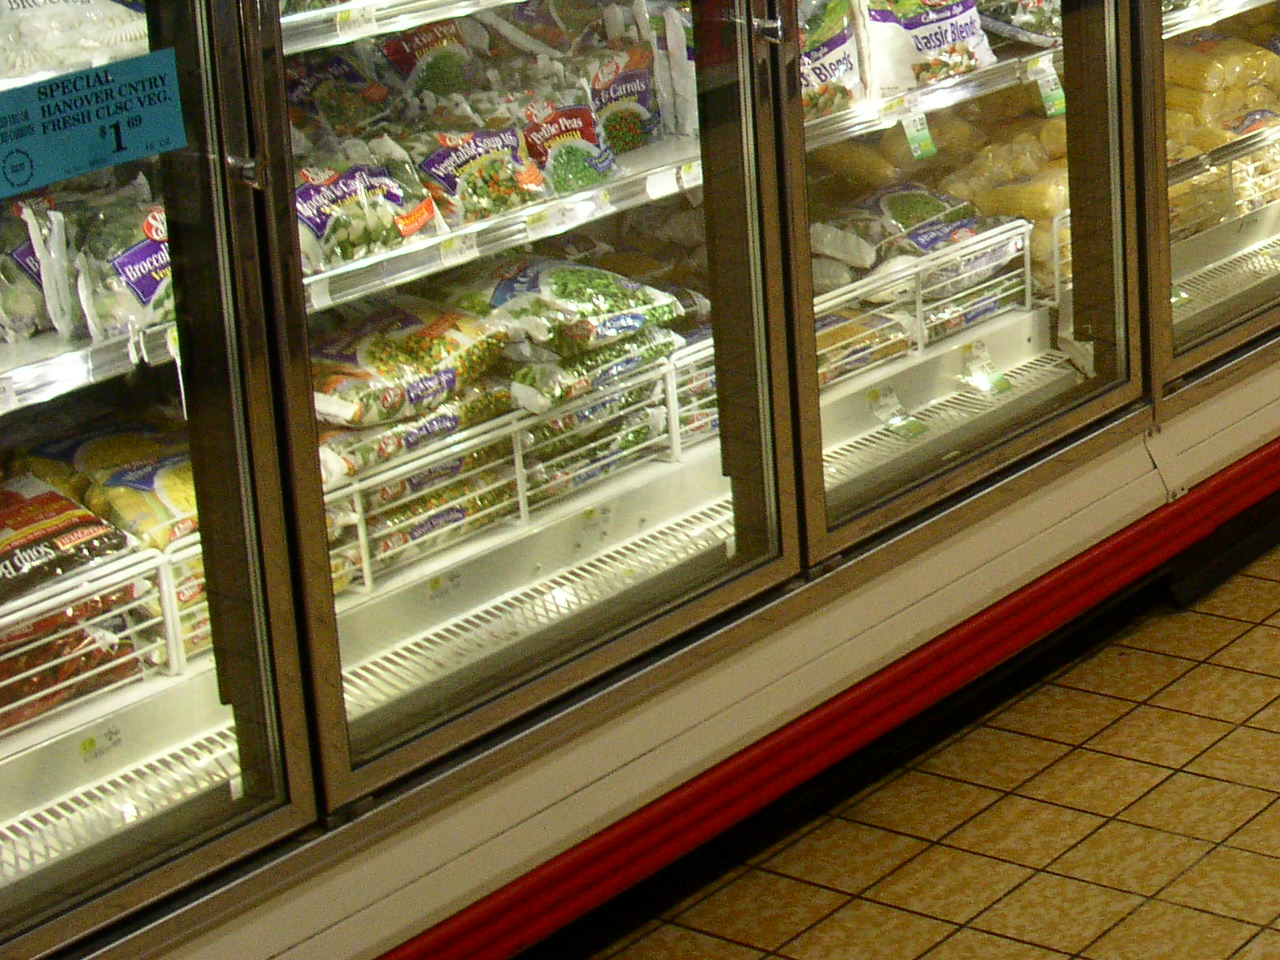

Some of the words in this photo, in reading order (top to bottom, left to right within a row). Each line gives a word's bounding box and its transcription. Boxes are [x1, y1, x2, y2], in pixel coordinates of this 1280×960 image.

[950, 17, 977, 41] Blends
[812, 51, 854, 83] Blends
[37, 69, 115, 101] SPECIAL
[41, 89, 115, 118] HANOVER
[118, 73, 167, 97] CNTRY
[608, 79, 646, 98] Carrots
[42, 111, 92, 135] FRESH
[95, 100, 133, 120] CLSC
[559, 117, 583, 131] Peas
[125, 243, 170, 282] Broccol
[14, 540, 56, 568] Soup
